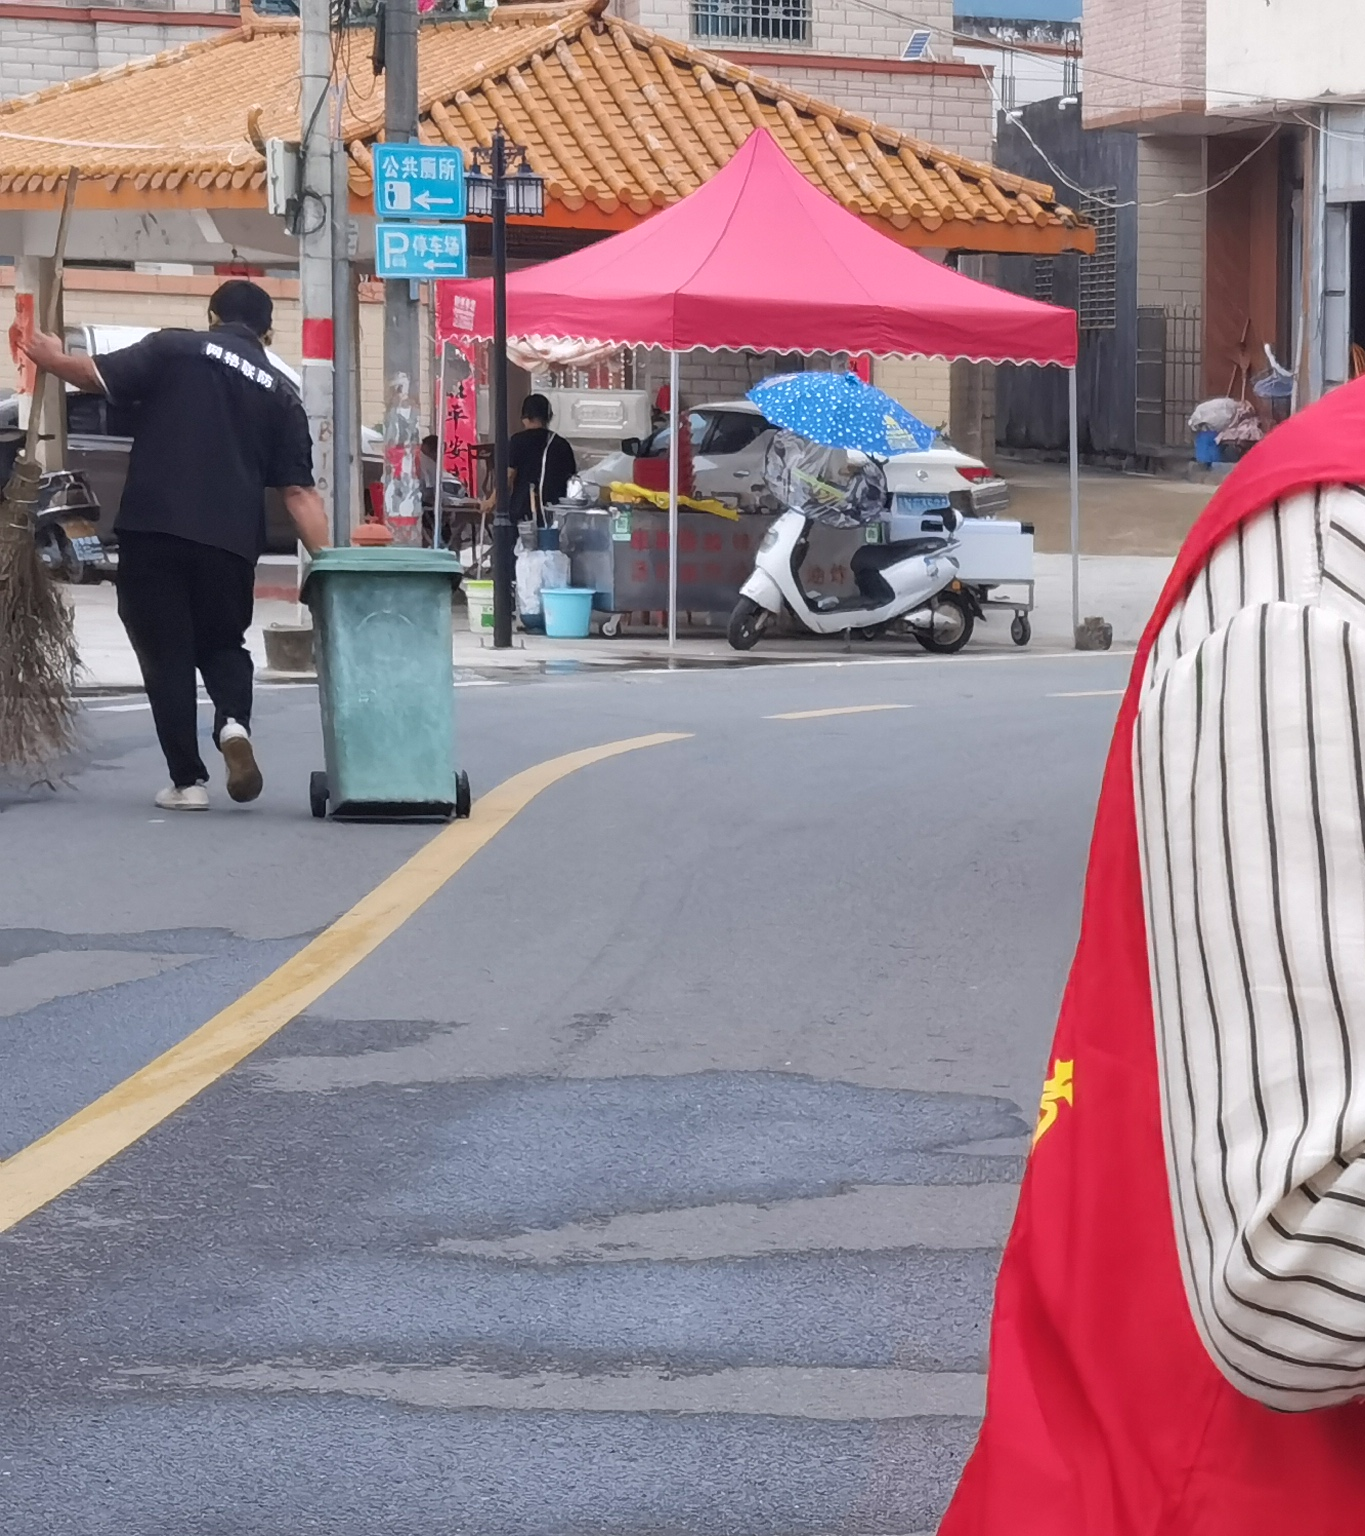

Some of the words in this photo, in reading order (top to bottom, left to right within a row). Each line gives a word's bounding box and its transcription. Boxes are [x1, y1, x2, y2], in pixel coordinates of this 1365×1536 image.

[382, 155, 456, 180] 公共厕所
[412, 235, 460, 257] 停车场
